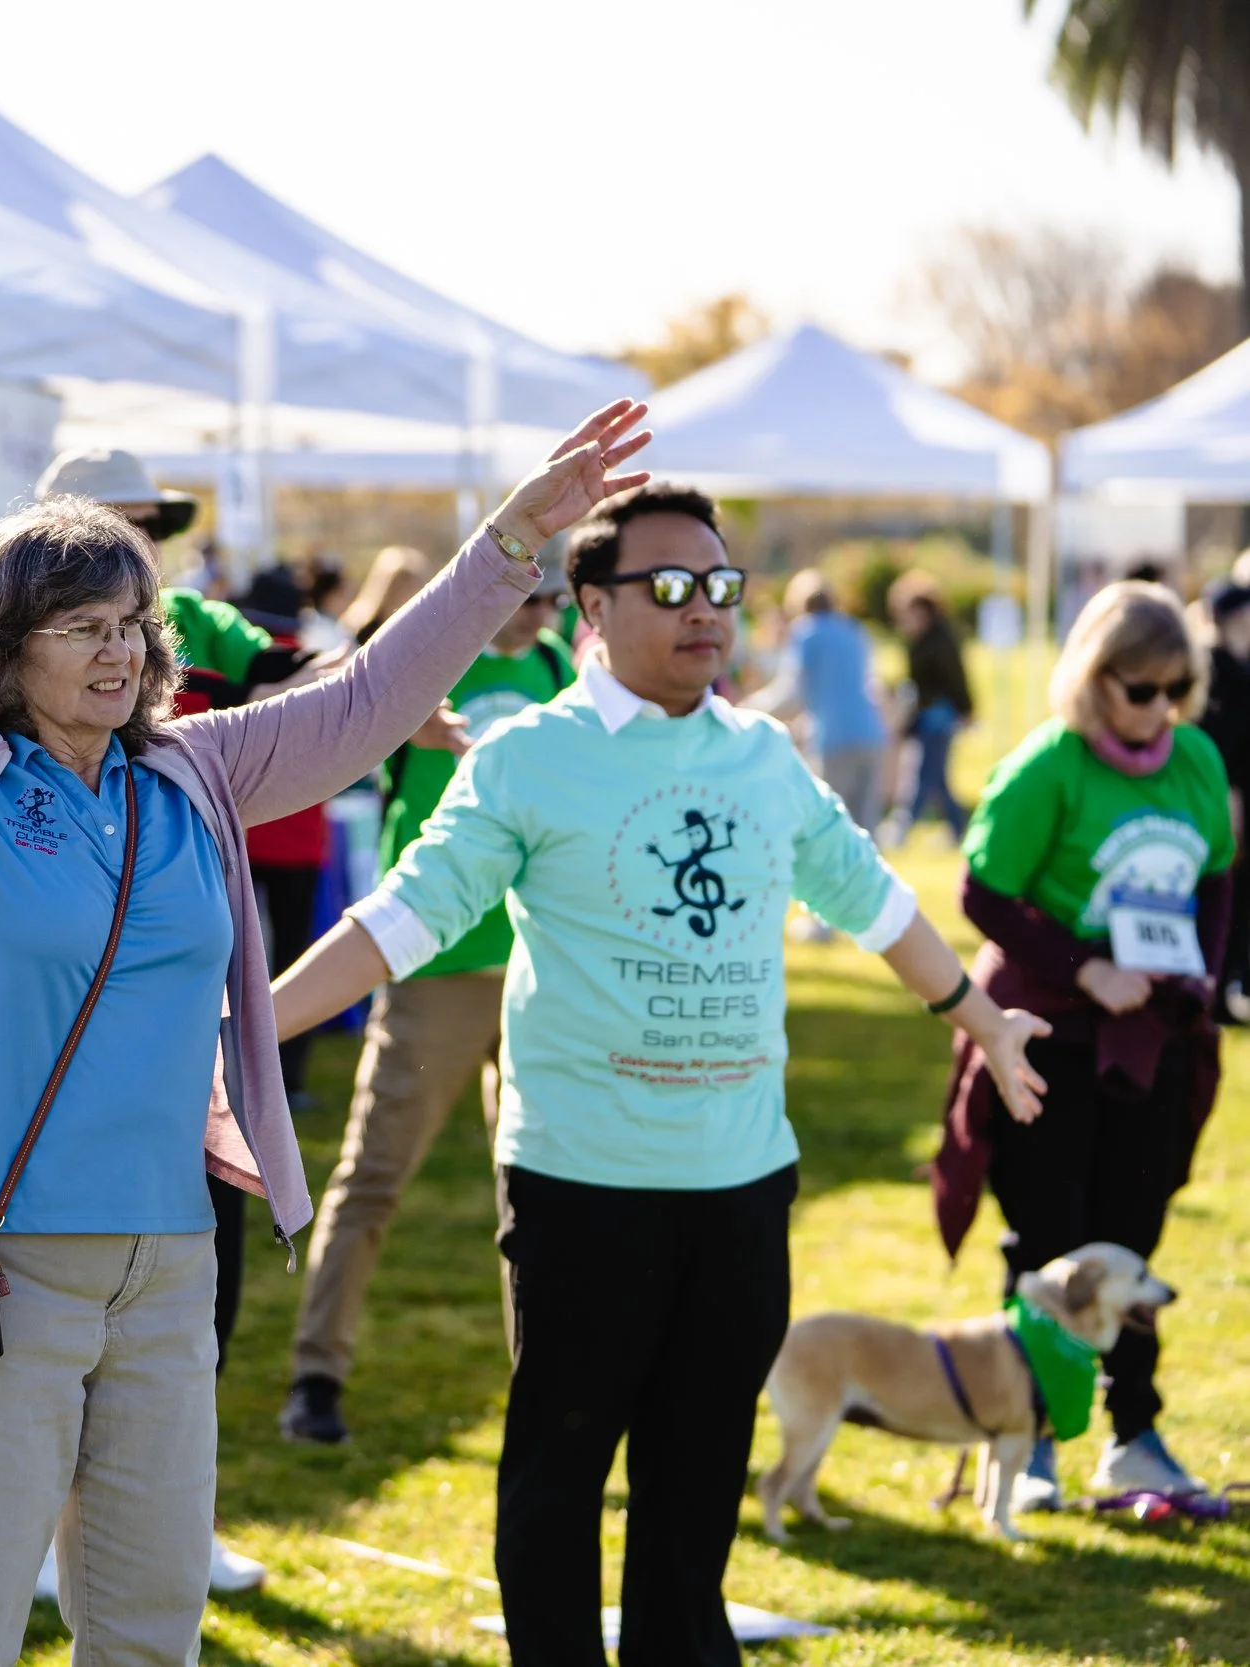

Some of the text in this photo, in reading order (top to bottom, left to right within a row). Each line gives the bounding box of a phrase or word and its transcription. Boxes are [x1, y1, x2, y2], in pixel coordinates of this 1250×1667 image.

[3, 816, 69, 841] TREMBLE
[15, 831, 59, 849] CLEFS
[15, 839, 58, 856] San Diego
[611, 956, 772, 985] TREMBLE
[647, 995, 760, 1019] CLEFS
[642, 1029, 760, 1050] San Diego
